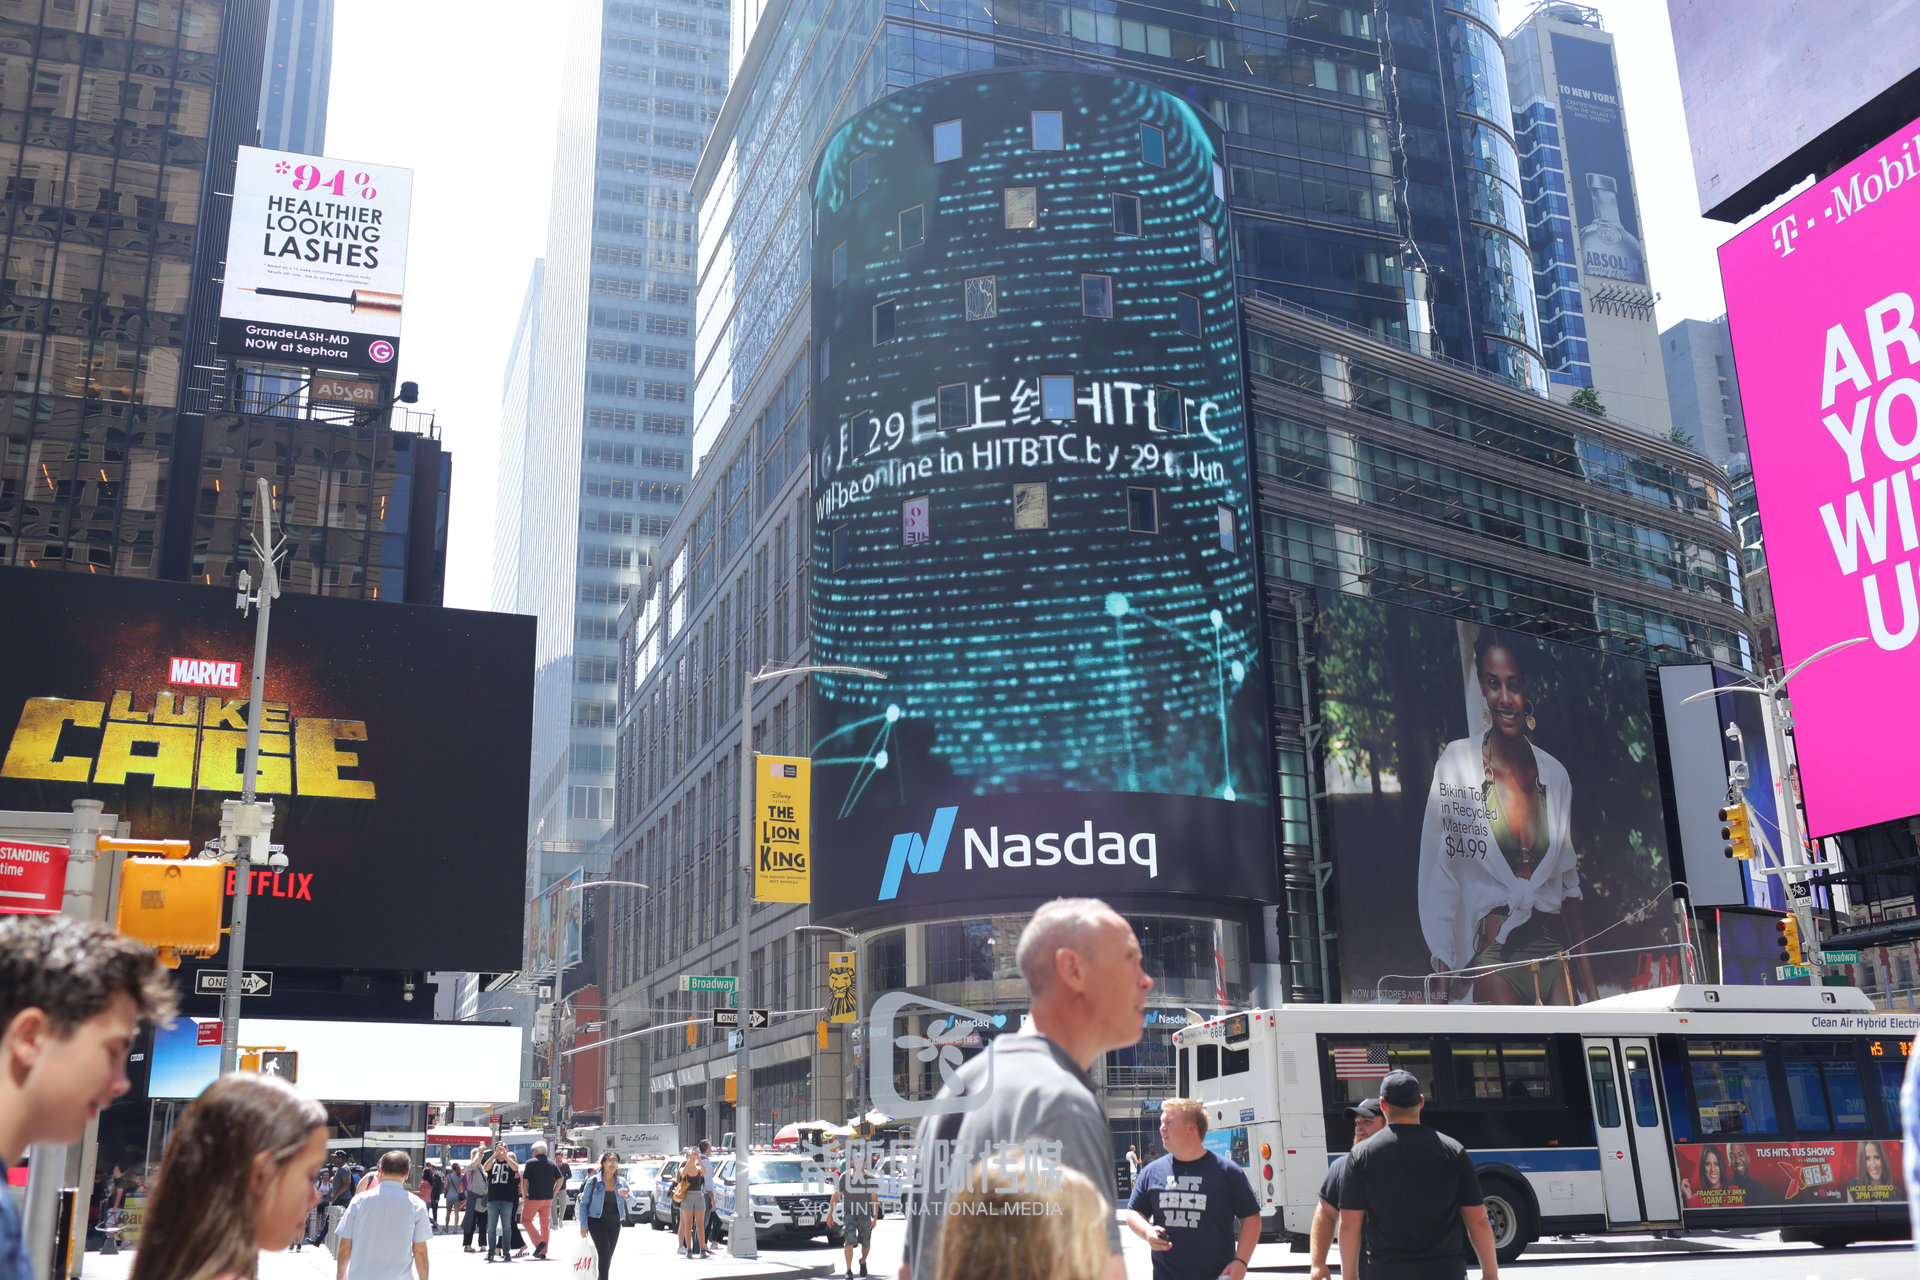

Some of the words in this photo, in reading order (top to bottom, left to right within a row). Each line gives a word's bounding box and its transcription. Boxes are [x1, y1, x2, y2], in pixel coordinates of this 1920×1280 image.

[1559, 84, 1570, 95] TO
[1572, 87, 1590, 99] NEW
[268, 195, 383, 225] HEALTHIER
[266, 213, 381, 243] LOOKING
[264, 232, 379, 269] LASHES
[246, 325, 350, 346] GrandeLASH-MD
[245, 338, 278, 350] NOW
[280, 343, 294, 352] at
[296, 344, 348, 358] Sephora
[318, 382, 374, 400] Absen
[940, 446, 964, 475] in
[972, 433, 1078, 470] HITBTC
[1086, 435, 1119, 472] by
[1189, 451, 1226, 483] Jun
[170, 658, 240, 687] MARVEL
[108, 690, 290, 732] LUKE
[1, 696, 376, 800] CAGE
[770, 790, 792, 800] Disney
[1440, 782, 1466, 799] Bikini
[1468, 786, 1488, 804] Top
[768, 806, 794, 820] THE
[1441, 800, 1450, 814] in
[1452, 802, 1498, 821] Recycled
[763, 821, 800, 844] LION
[1442, 818, 1488, 836] Materials
[0, 847, 50, 864] STANDING
[964, 820, 1158, 878] Nasdaq
[1446, 834, 1487, 860] $4.99
[760, 845, 806, 872] KING
[226, 870, 314, 900] ETFLIX
[1826, 952, 1857, 964] Broadway
[1784, 968, 1791, 977] W
[208, 978, 228, 987] ONE
[692, 978, 734, 992] Broadway
[1352, 988, 1370, 998] NOW
[1370, 989, 1378, 998] IN
[1380, 990, 1406, 999] STORES
[1407, 990, 1422, 1000] AND
[1424, 991, 1448, 1000] ONLINE
[722, 1014, 736, 1022] ONE
[955, 1019, 990, 1028] Nasdaq
[1158, 1014, 1190, 1026] Nasdaq
[1812, 1017, 1838, 1028] Clean
[1840, 1017, 1853, 1028] Air
[1856, 1018, 1887, 1030] Hybrid
[1210, 1026, 1226, 1038] 6692
[1899, 1042, 1907, 1050] 31
[621, 1134, 632, 1142] Pat
[632, 1134, 659, 1142] LaFrieda
[1756, 1148, 1771, 1157] TUS
[1772, 1148, 1790, 1158] HITS,
[1791, 1148, 1805, 1156] TUS
[1807, 1147, 1835, 1156] SHOWS
[492, 1163, 509, 1184] 96
[1803, 1164, 1834, 1186] 96.3
[1703, 1196, 1723, 1204] 10AM
[1727, 1196, 1743, 1204] 3PM
[1874, 1191, 1889, 1199] 7PM
